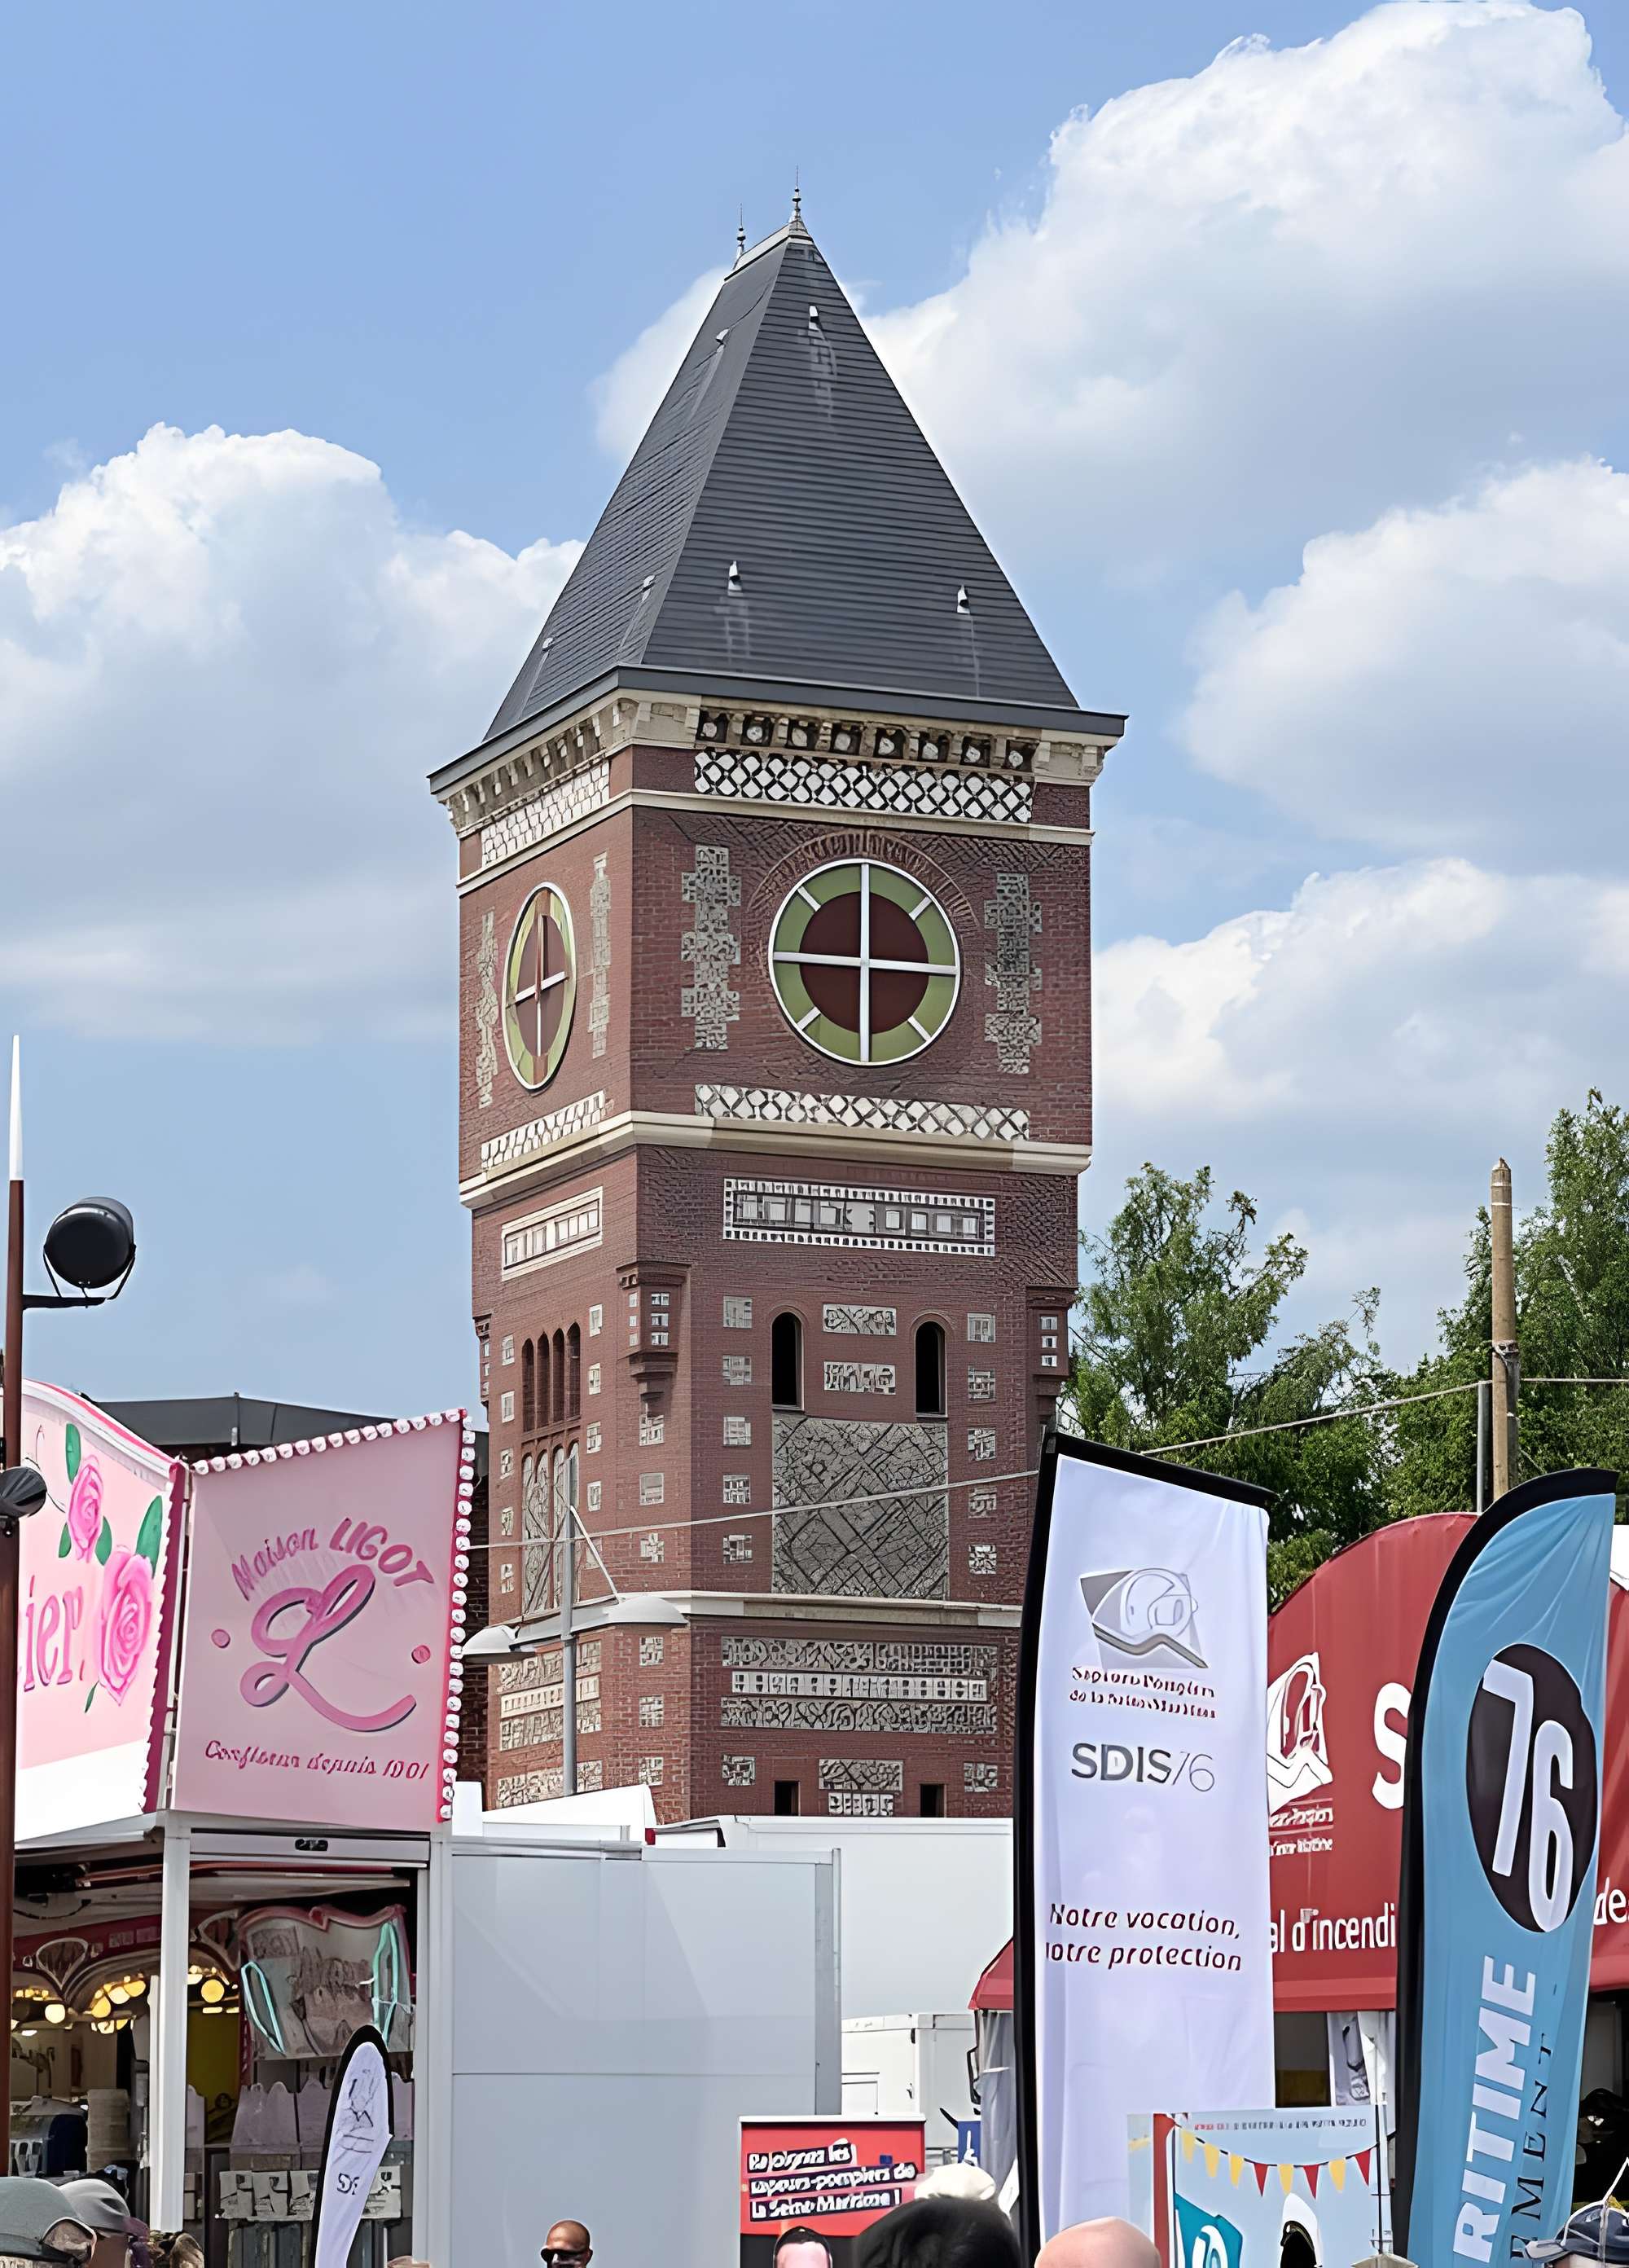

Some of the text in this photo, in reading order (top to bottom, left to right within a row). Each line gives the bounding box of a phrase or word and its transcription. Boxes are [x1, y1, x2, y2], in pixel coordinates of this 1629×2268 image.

[232, 1518, 434, 1601] Maison LIGOT
[1372, 1682, 1412, 1809] S
[1482, 1659, 1574, 1932] 76
[1050, 1903, 1240, 1940] Notre vocation,
[1292, 1901, 1396, 1952] d'incendi
[1593, 1877, 1629, 1926] de
[1108, 1945, 1242, 1971] protection
